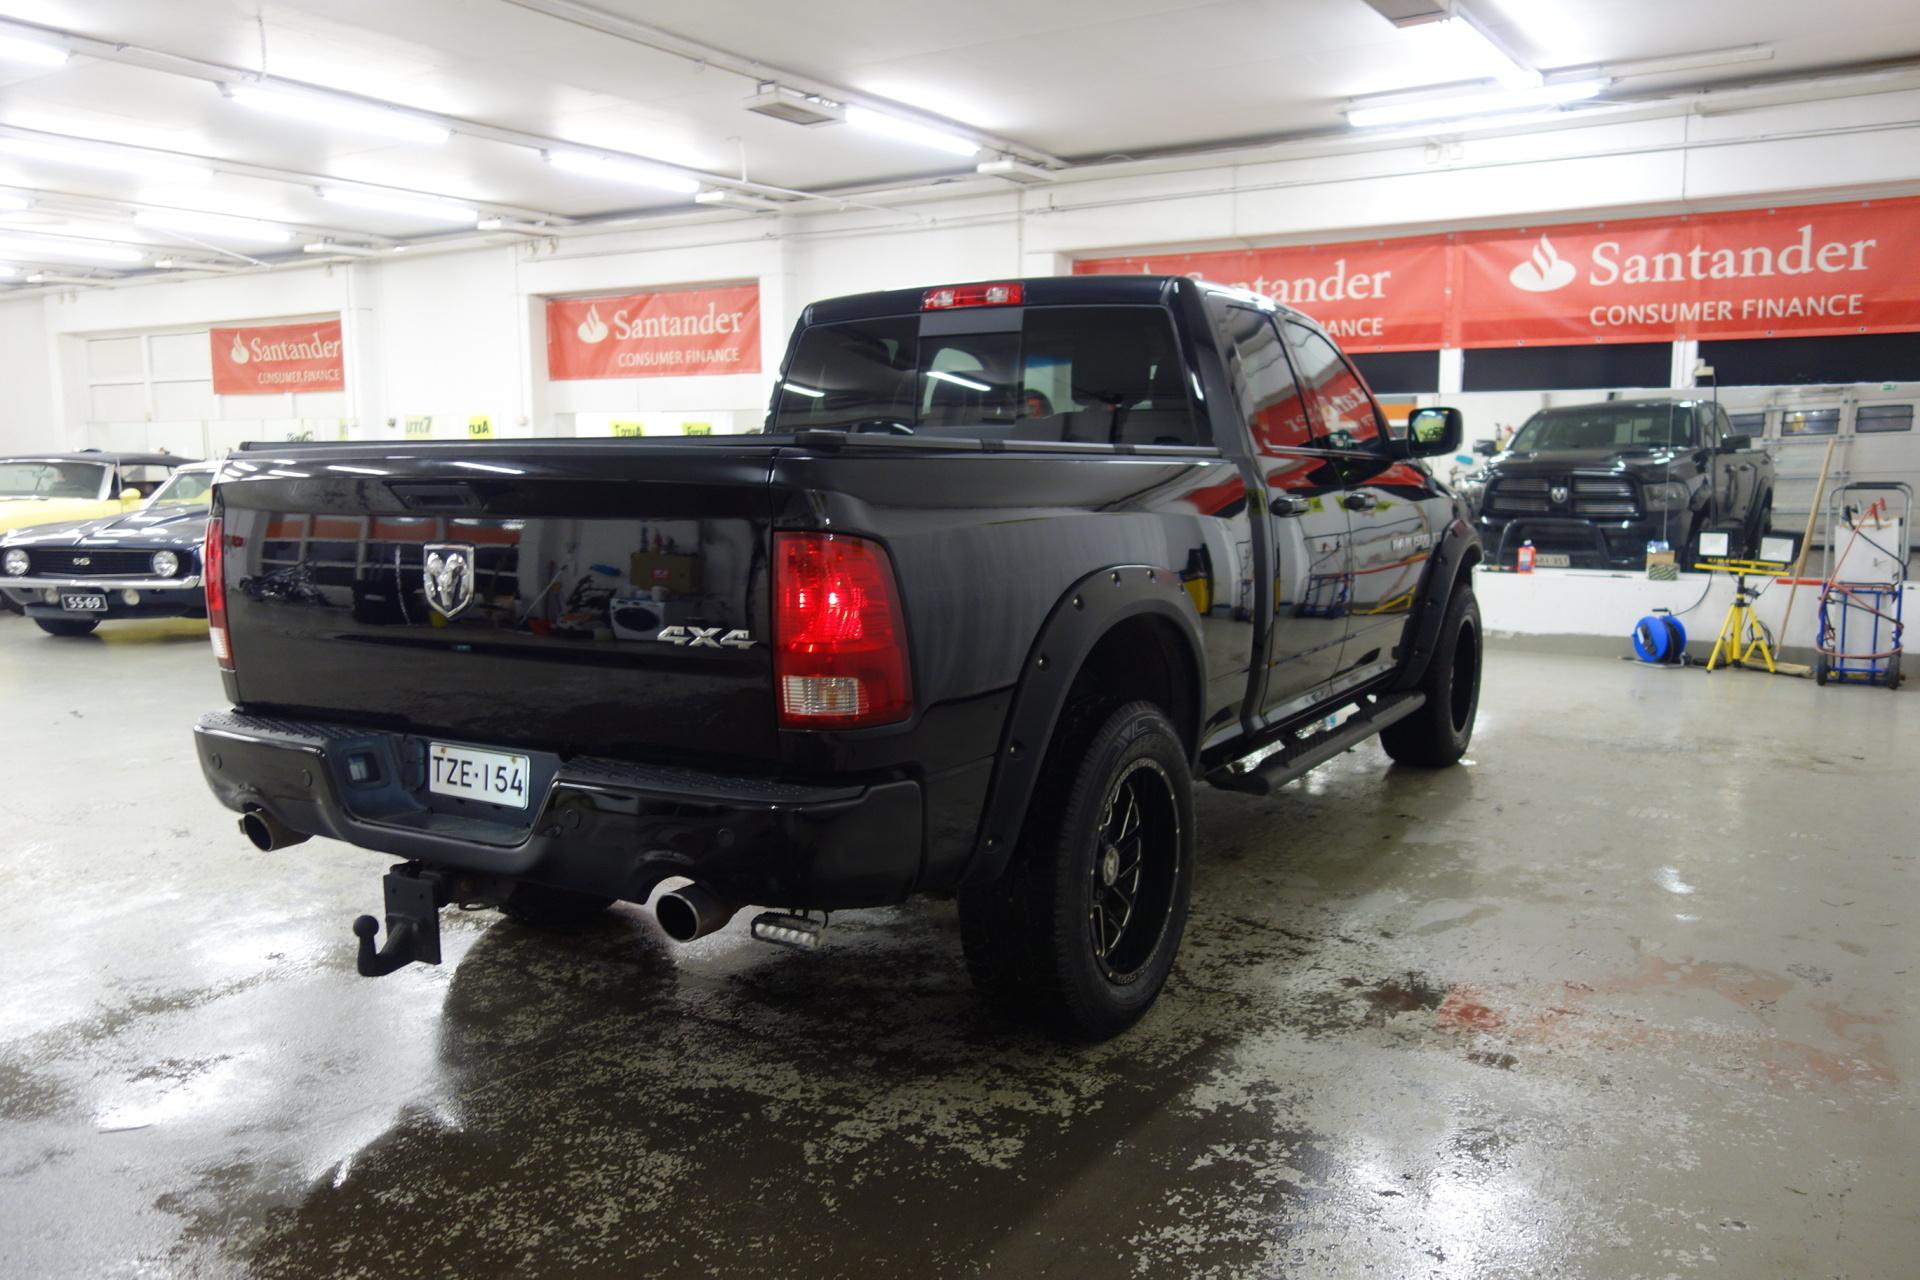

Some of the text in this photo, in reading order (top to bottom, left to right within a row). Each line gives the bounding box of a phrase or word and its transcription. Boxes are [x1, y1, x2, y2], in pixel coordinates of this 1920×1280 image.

[1589, 224, 1877, 287] Santander
[613, 302, 743, 340] Santander
[1589, 294, 1864, 326] CONSUMER FINANCE
[250, 331, 341, 362] Santander
[618, 347, 740, 367] CONSUMER FINANCE
[258, 371, 301, 384] CONSUMER
